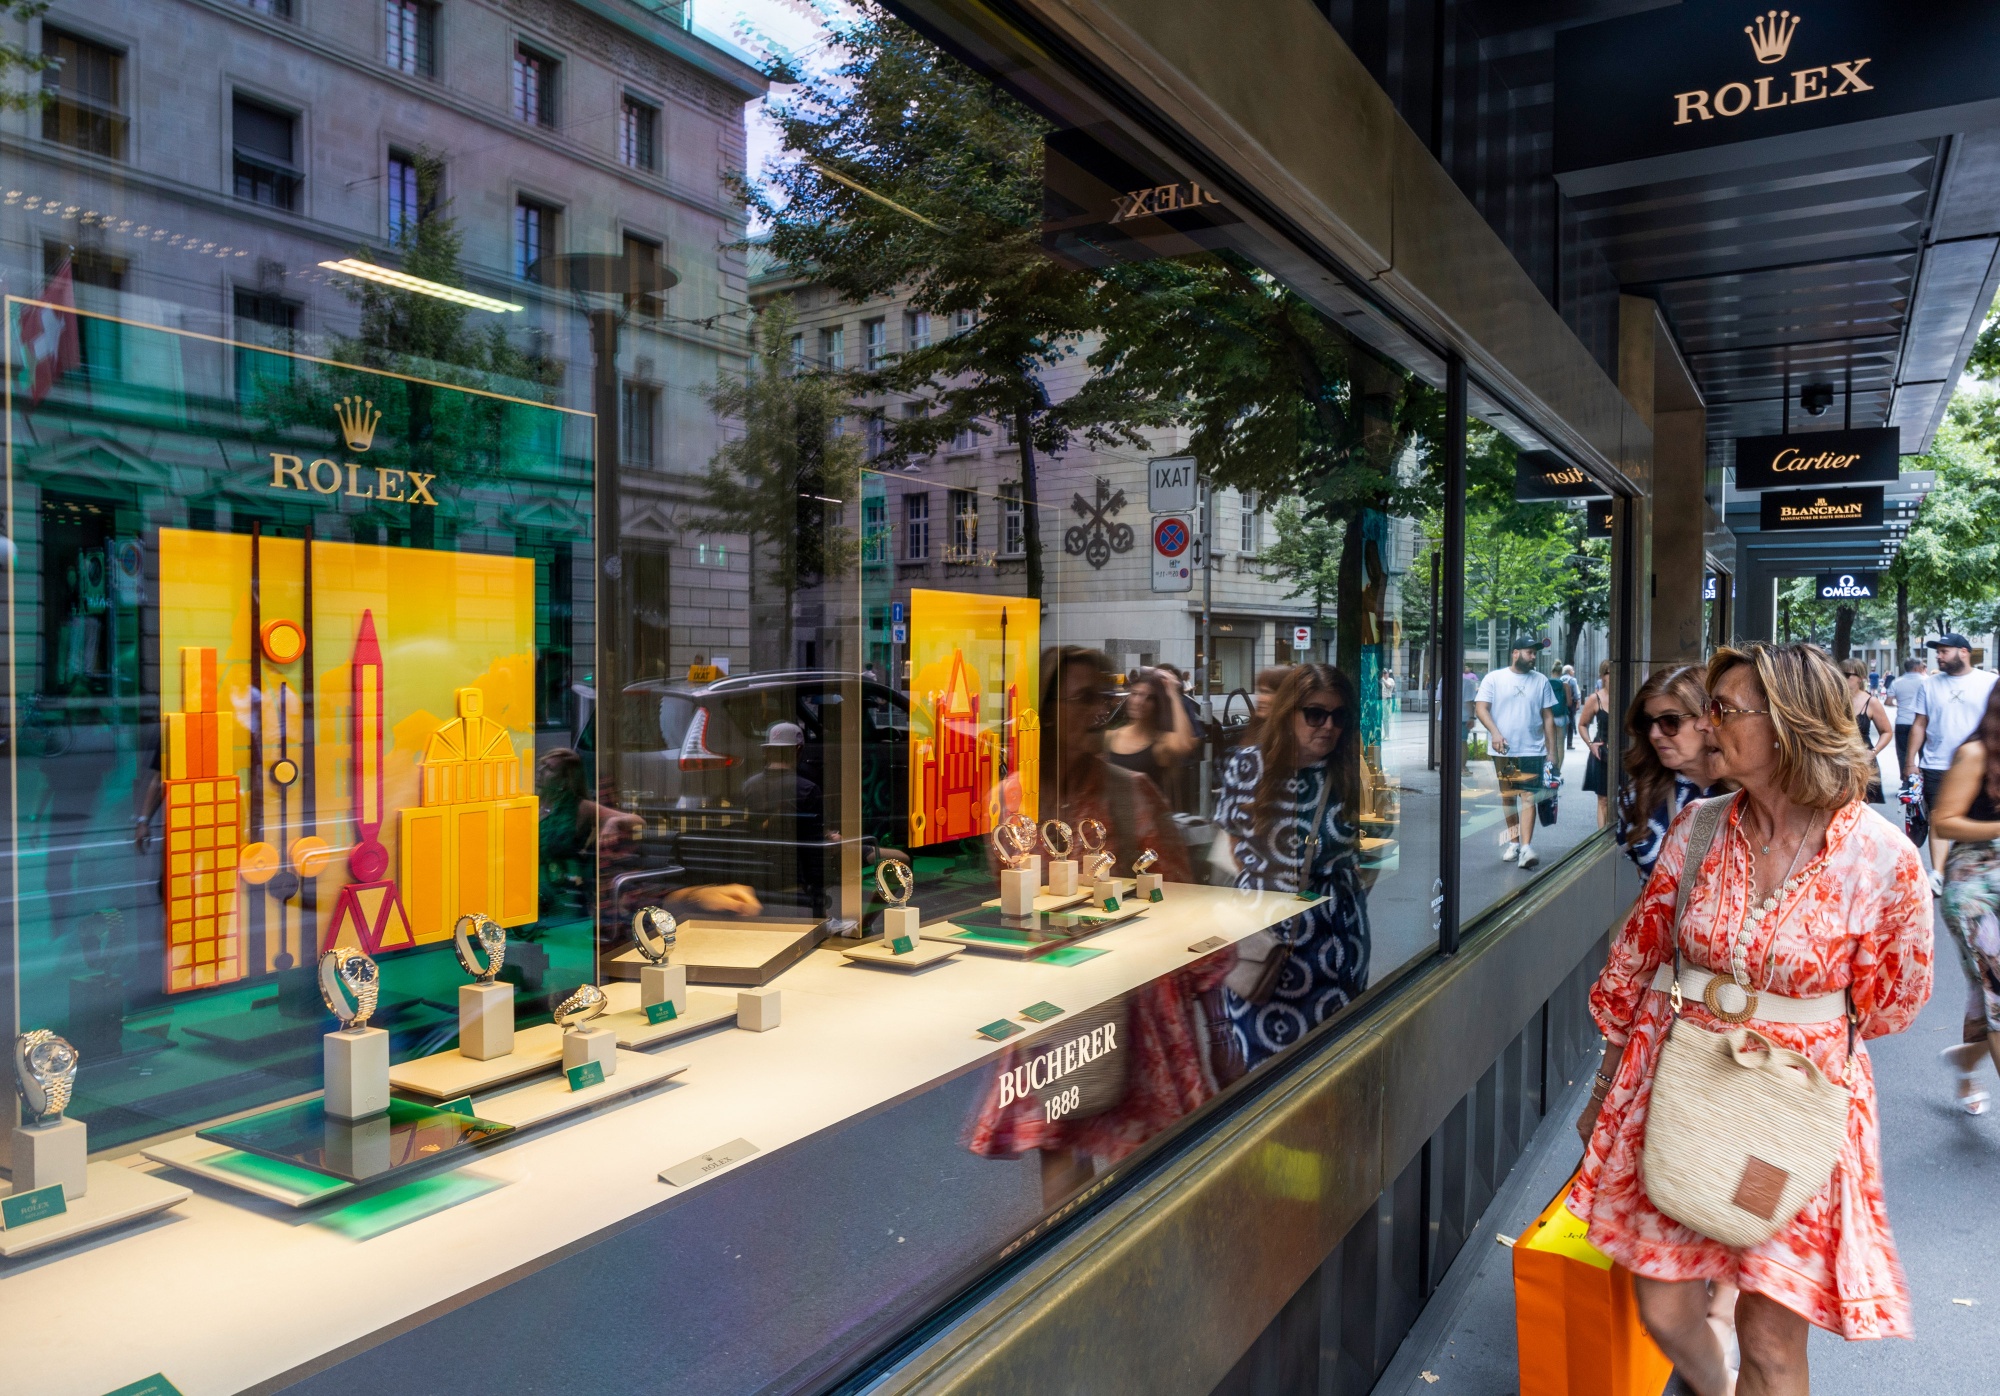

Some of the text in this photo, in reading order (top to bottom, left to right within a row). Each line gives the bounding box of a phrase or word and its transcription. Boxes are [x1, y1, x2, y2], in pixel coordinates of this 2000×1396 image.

[1673, 57, 1875, 126] ROLEX
[1772, 448, 1860, 472] Cartier
[269, 452, 439, 506] ROLEX
[1780, 503, 1862, 517] BLANCPAIN
[1822, 586, 1871, 598] OMEGA
[998, 1021, 1118, 1109] BUCHERER
[1044, 1085, 1080, 1124] 1888
[701, 1156, 733, 1173] ROLEX
